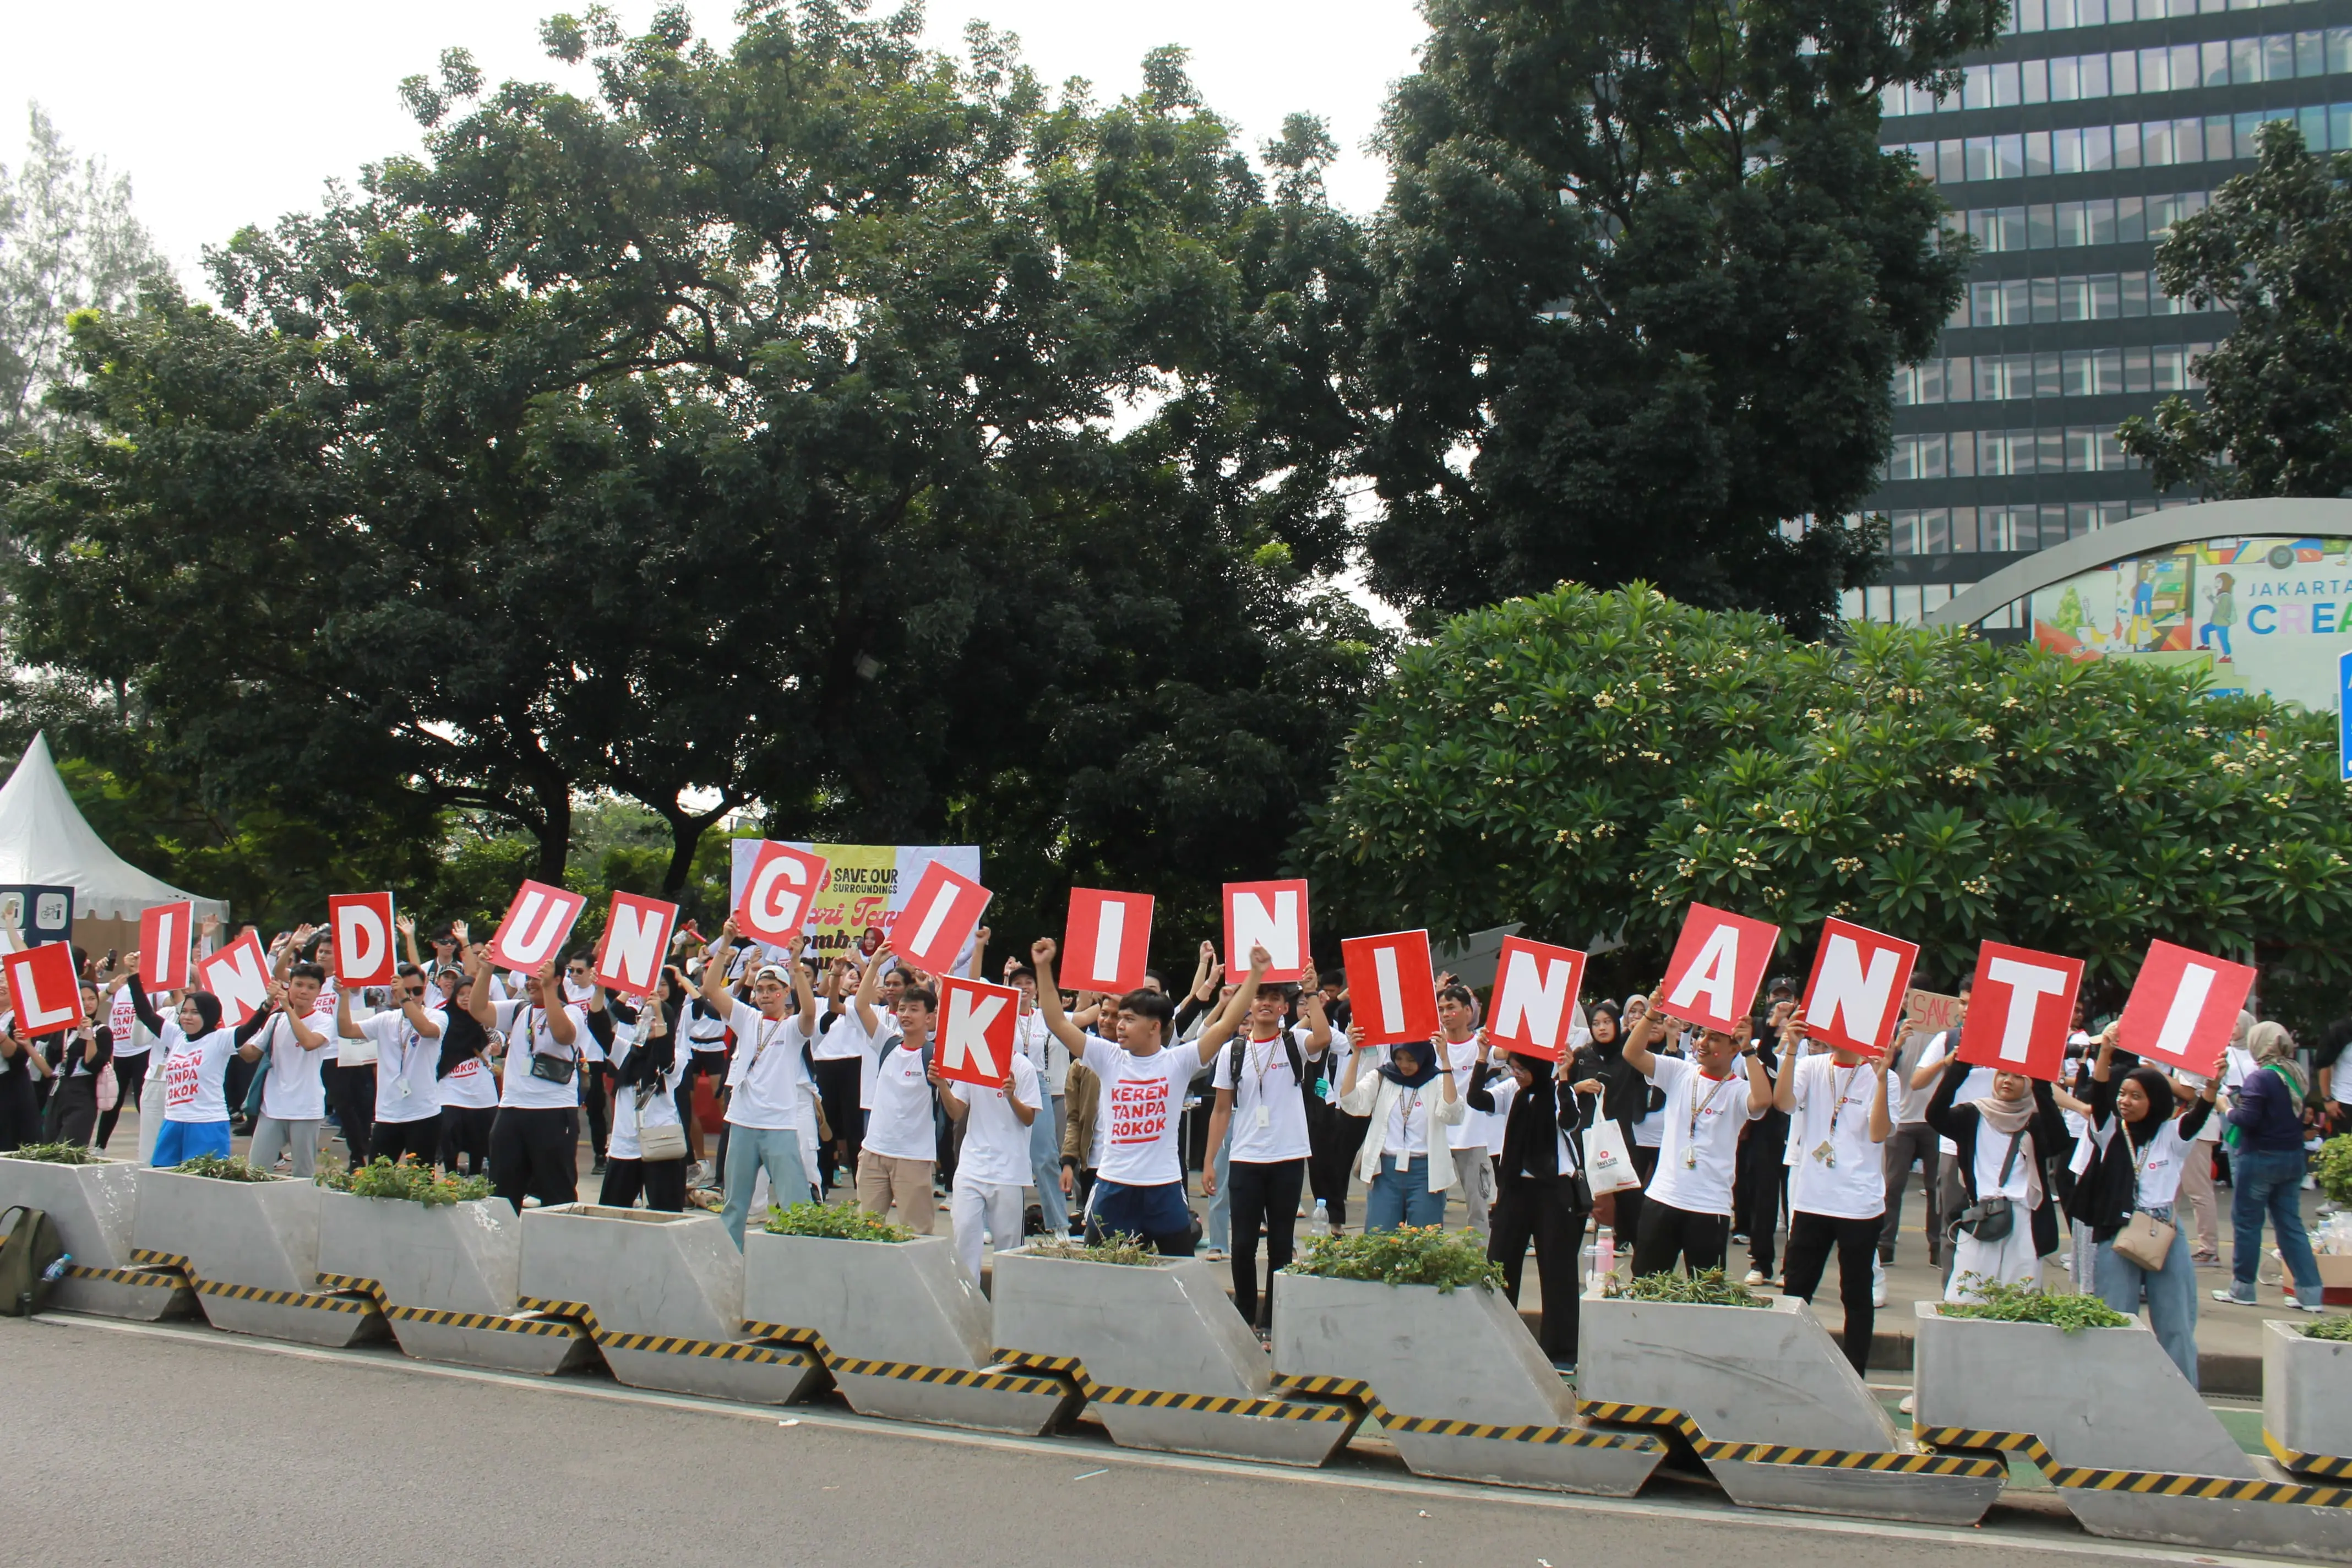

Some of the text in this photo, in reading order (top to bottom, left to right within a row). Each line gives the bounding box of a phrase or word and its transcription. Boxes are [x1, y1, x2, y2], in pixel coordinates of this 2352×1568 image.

[2248, 579, 2352, 597] JAKARTA
[749, 856, 807, 933] G
[832, 883, 898, 895] SURROUNDINGS
[834, 868, 899, 884] SAVE OUR
[156, 912, 173, 983] I
[338, 905, 385, 979] D
[501, 890, 571, 963] U
[601, 903, 665, 988] N
[910, 880, 961, 958] I
[1092, 900, 1125, 982] I
[1233, 890, 1299, 971] N
[14, 961, 73, 1028] L
[206, 943, 268, 1028] N
[312, 997, 336, 1006] REN
[1374, 946, 1406, 1034] I
[1495, 950, 1572, 1049] N
[1668, 923, 1739, 1022] A
[1805, 933, 1901, 1046] N
[2155, 962, 2217, 1055] I
[112, 1006, 137, 1015] KERE
[943, 988, 1008, 1079] K
[1913, 994, 1954, 1028] SAVE
[1988, 957, 2068, 1064] T
[166, 1055, 202, 1071] EREN
[166, 1069, 198, 1086] ANPA
[167, 1082, 199, 1099] OKOK
[1111, 1083, 1169, 1102] KEREN
[1112, 1101, 1166, 1120] TANPA
[1112, 1116, 1167, 1137] ROKOK
